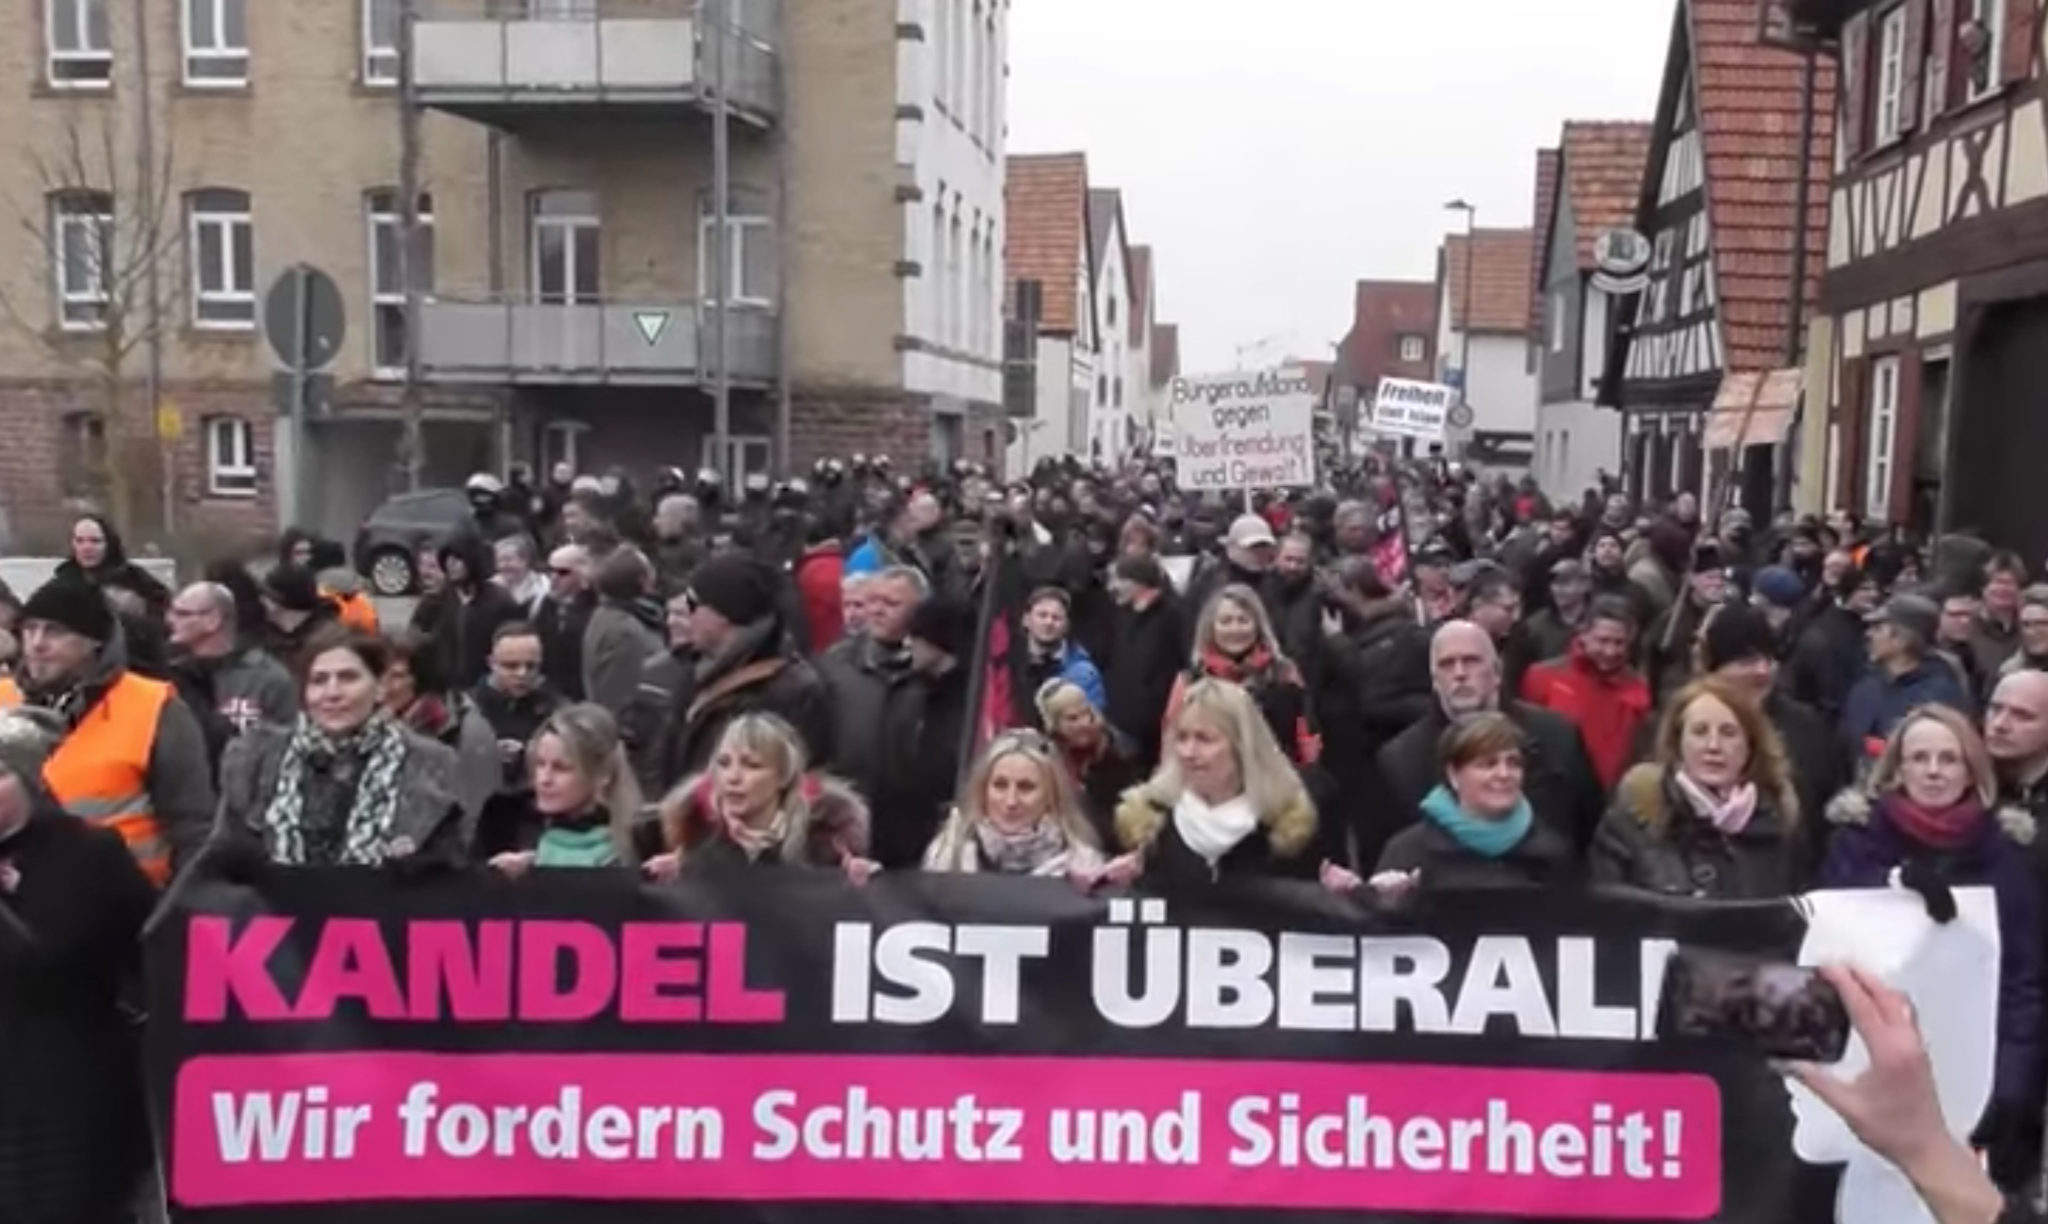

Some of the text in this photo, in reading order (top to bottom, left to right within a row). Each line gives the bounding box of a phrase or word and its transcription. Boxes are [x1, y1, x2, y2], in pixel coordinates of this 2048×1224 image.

[1213, 405, 1270, 429] gegen
[1192, 461, 1227, 486] und
[183, 916, 786, 1023] KANDEL
[832, 922, 1051, 1025] IST
[213, 1082, 1683, 1179] Wir fordern Schutz und Sicherheit!
